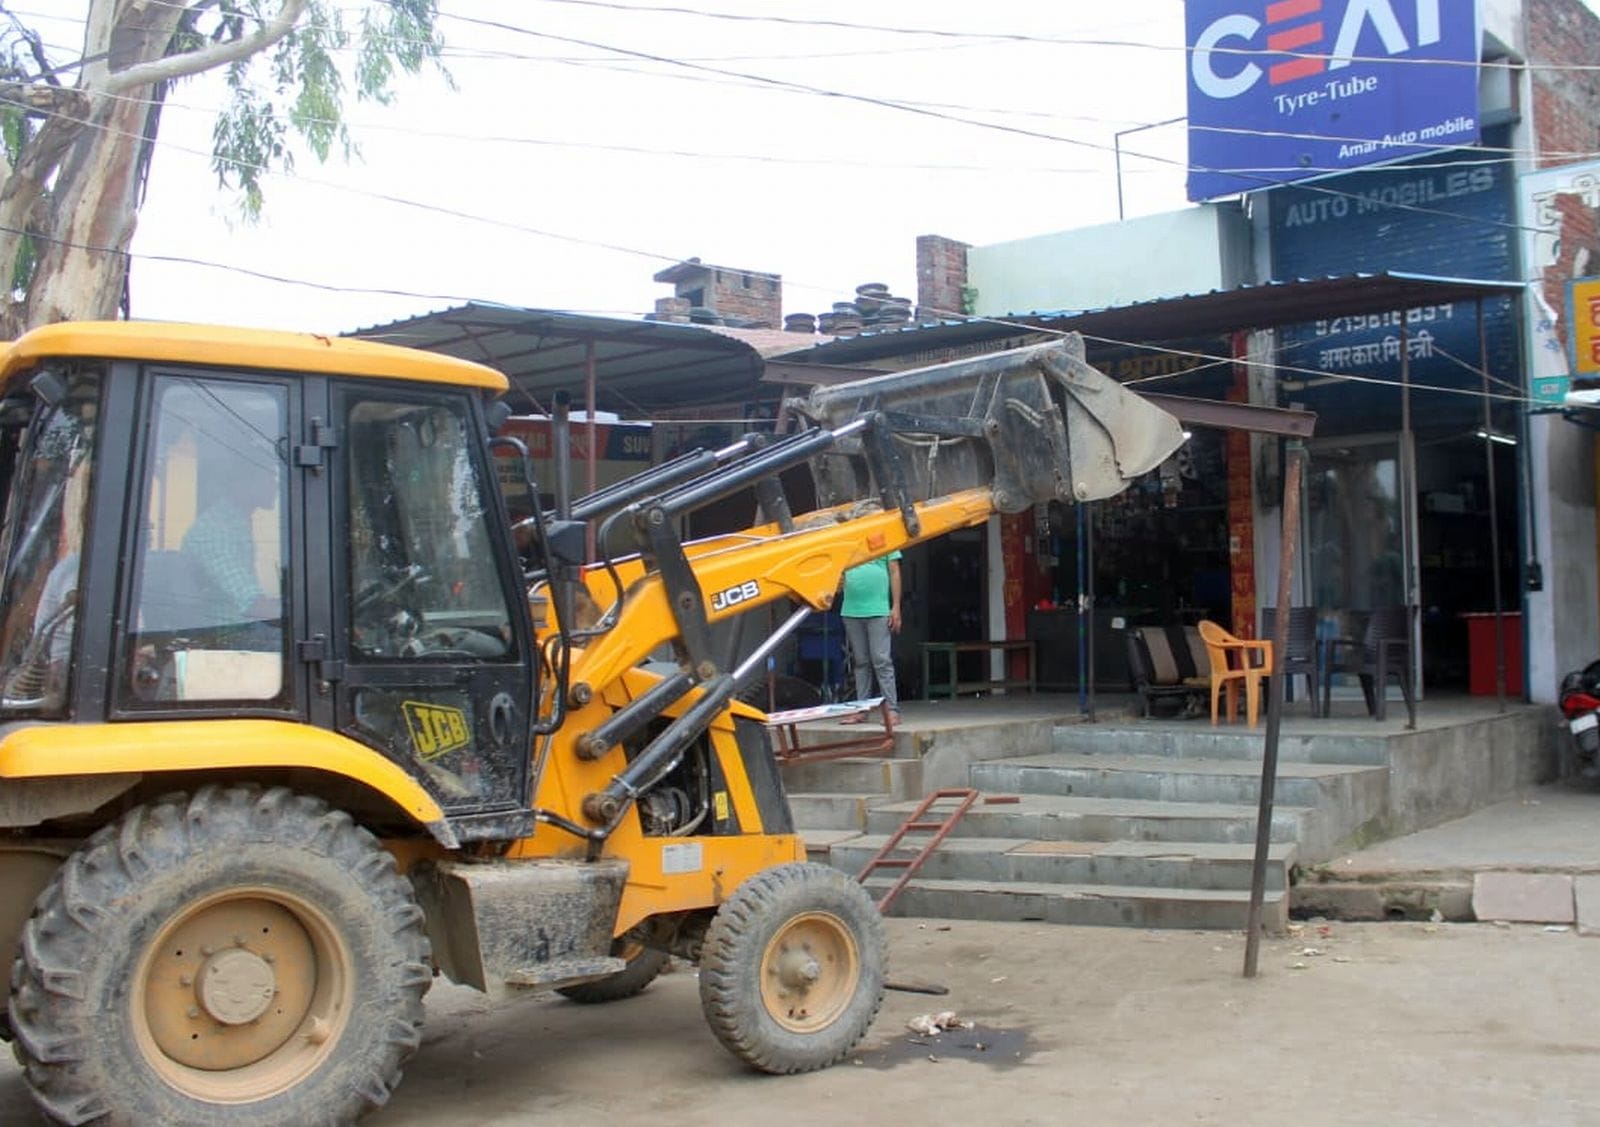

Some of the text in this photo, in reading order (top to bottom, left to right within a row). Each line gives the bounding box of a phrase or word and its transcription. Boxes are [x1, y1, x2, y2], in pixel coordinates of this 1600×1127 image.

[1274, 76, 1378, 116] Tyre-Tube
[1338, 117, 1474, 159] Amar Auto mobile
[1285, 195, 1349, 228] AUTO
[1356, 166, 1495, 214] MOBILES
[713, 580, 760, 610] JCB
[414, 706, 464, 753] JCB
